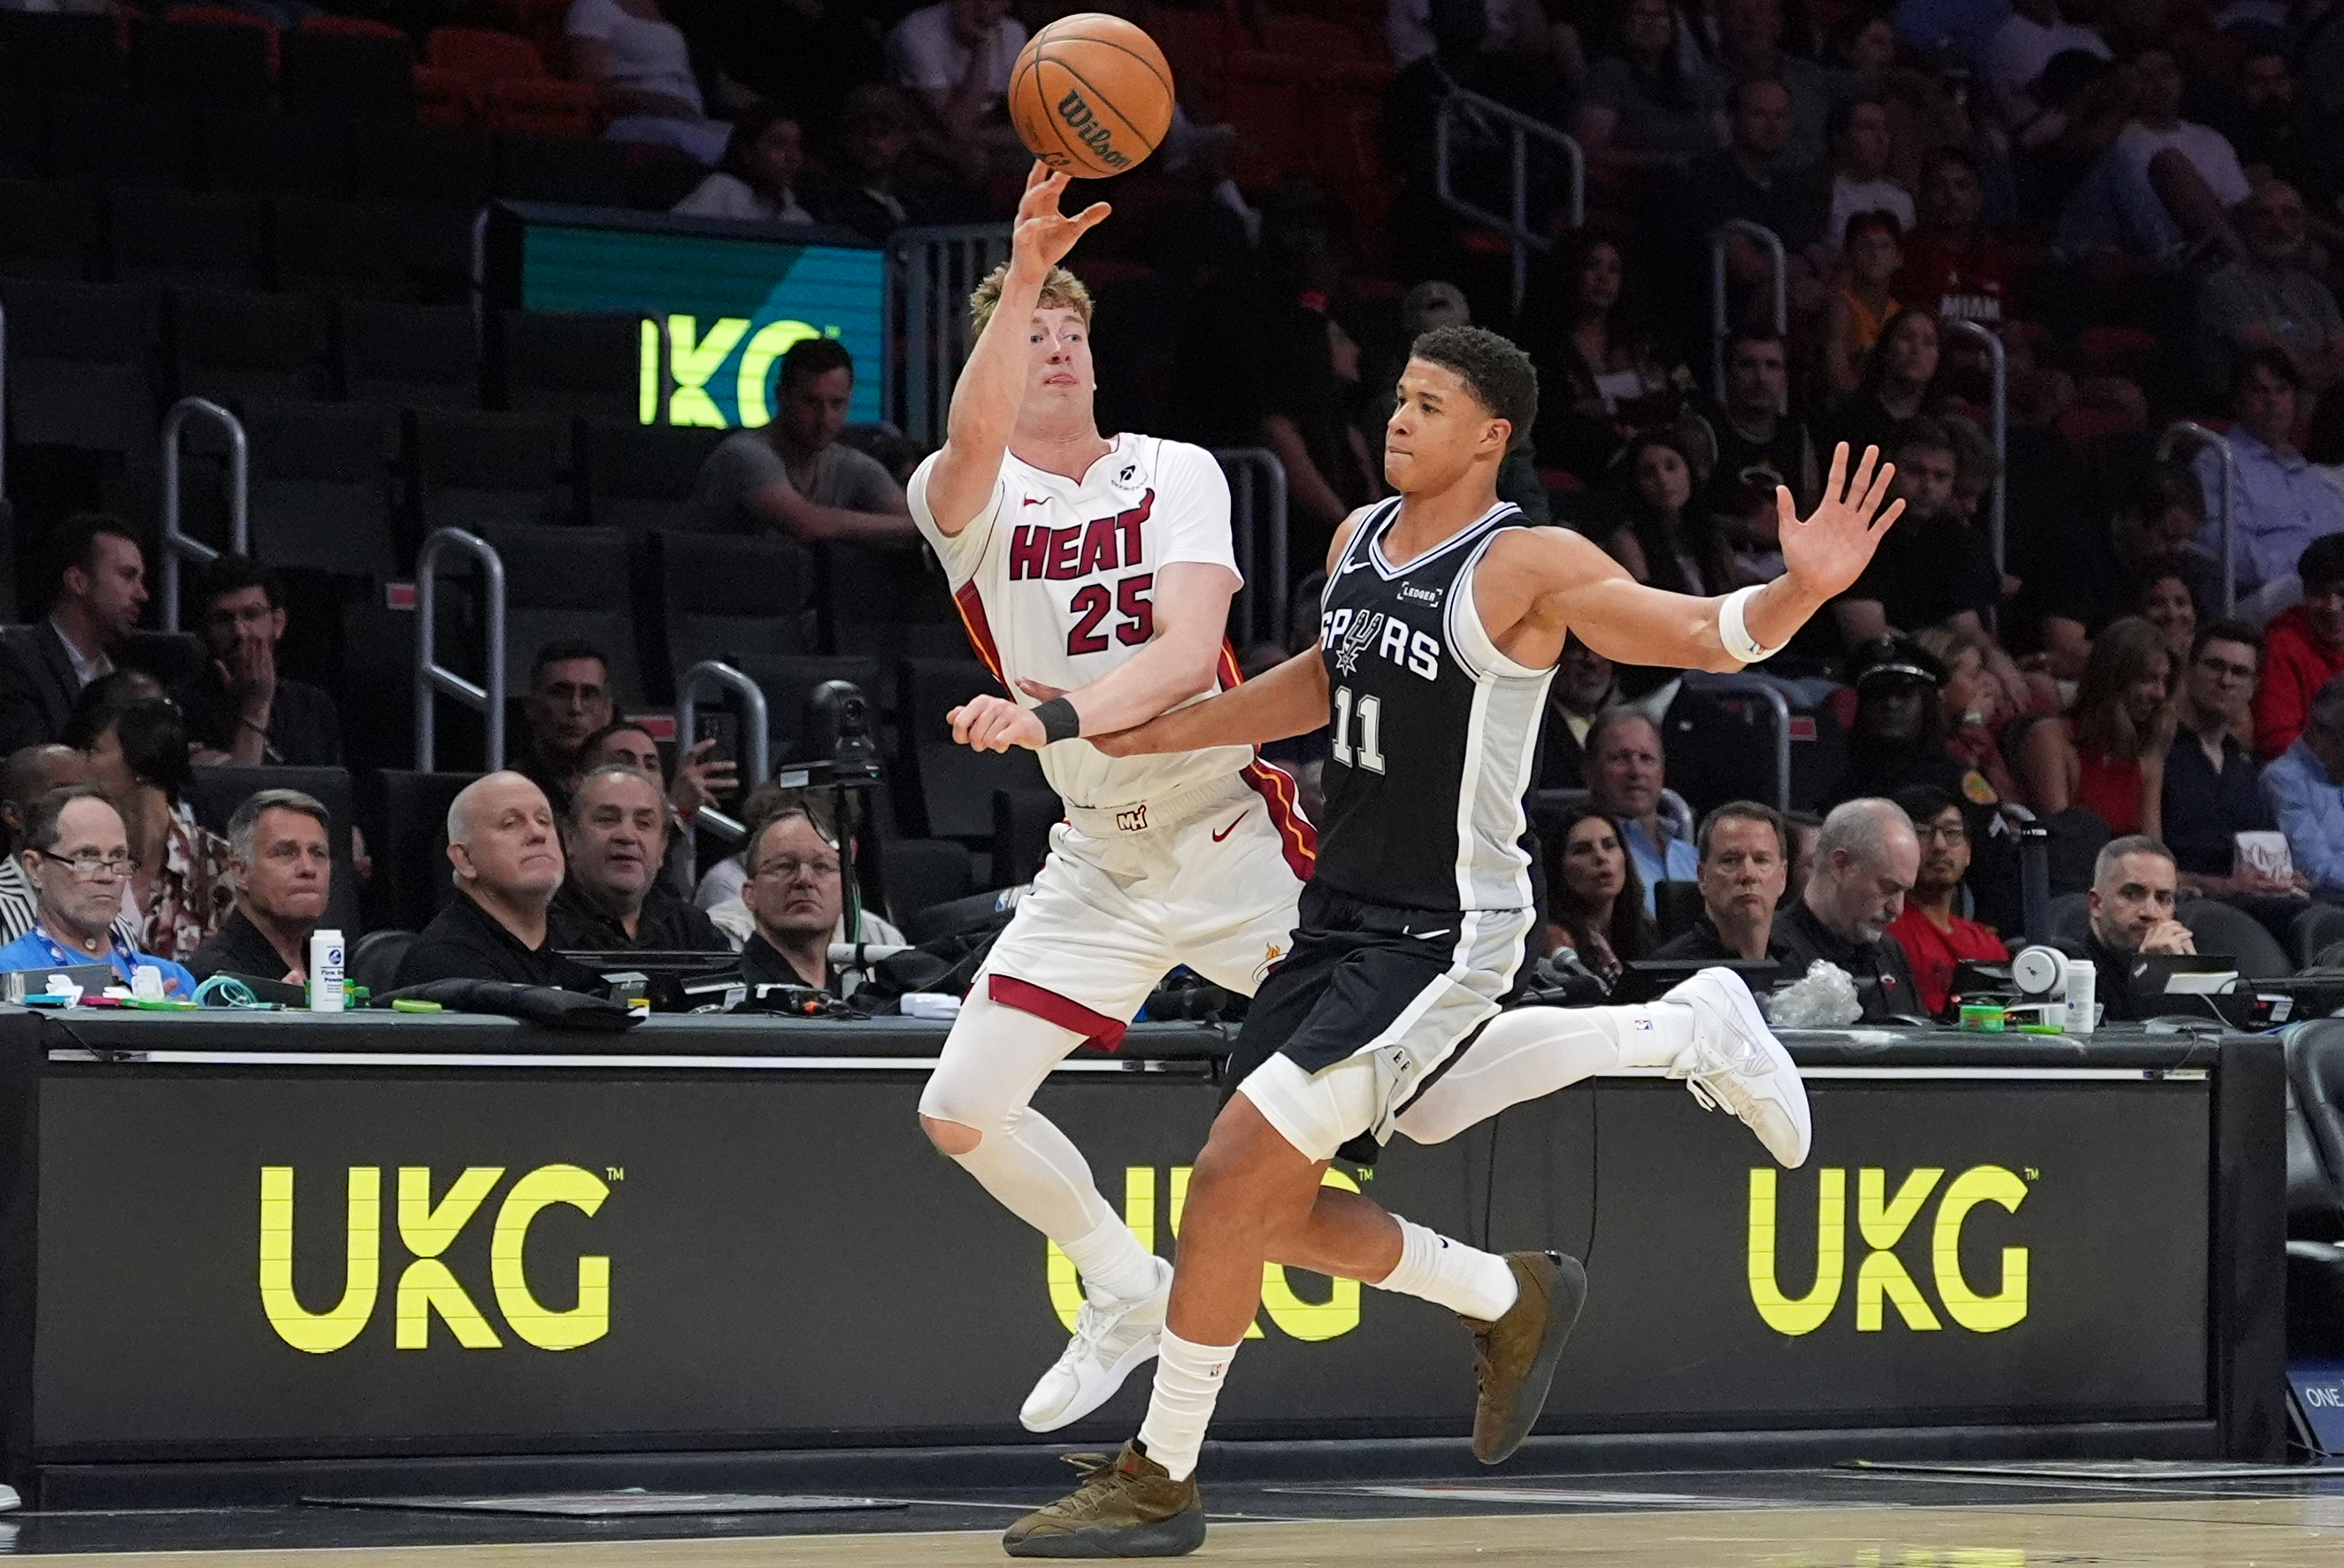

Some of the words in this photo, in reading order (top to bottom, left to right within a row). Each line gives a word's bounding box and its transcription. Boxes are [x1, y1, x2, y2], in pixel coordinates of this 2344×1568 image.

[1058, 89, 1132, 170] Wilson
[1010, 488, 1155, 580] HEAT
[1066, 573, 1154, 656] 25
[1403, 586, 1436, 602] LEDGER
[1332, 685, 1386, 775] 11
[259, 1164, 611, 1354] UKG
[1748, 1164, 2029, 1336] UKG
[2306, 1387, 2344, 1408] ONE
